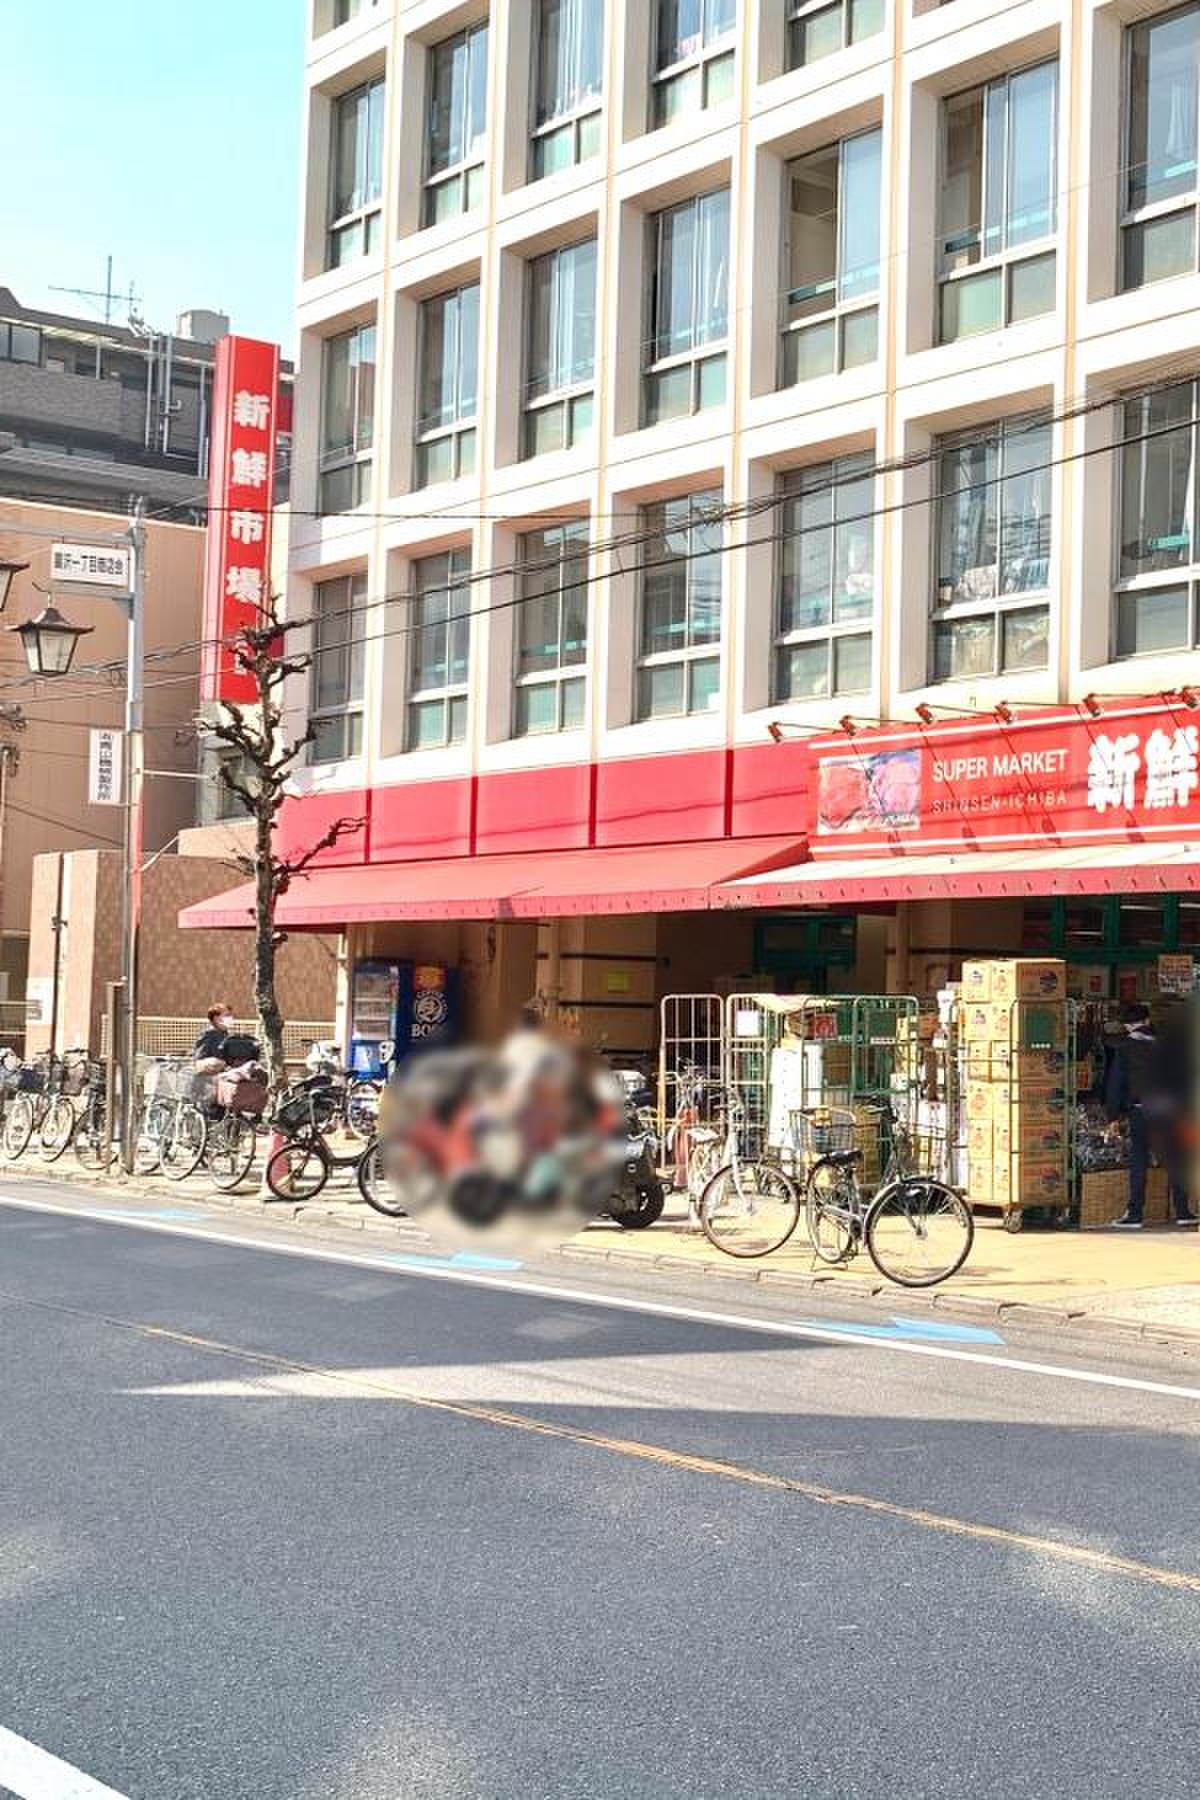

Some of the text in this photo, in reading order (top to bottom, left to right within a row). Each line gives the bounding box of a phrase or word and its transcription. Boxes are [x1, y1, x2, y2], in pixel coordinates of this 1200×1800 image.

[226, 390, 270, 602] 新鮮市場
[932, 748, 1069, 783] SUPER MARKET
